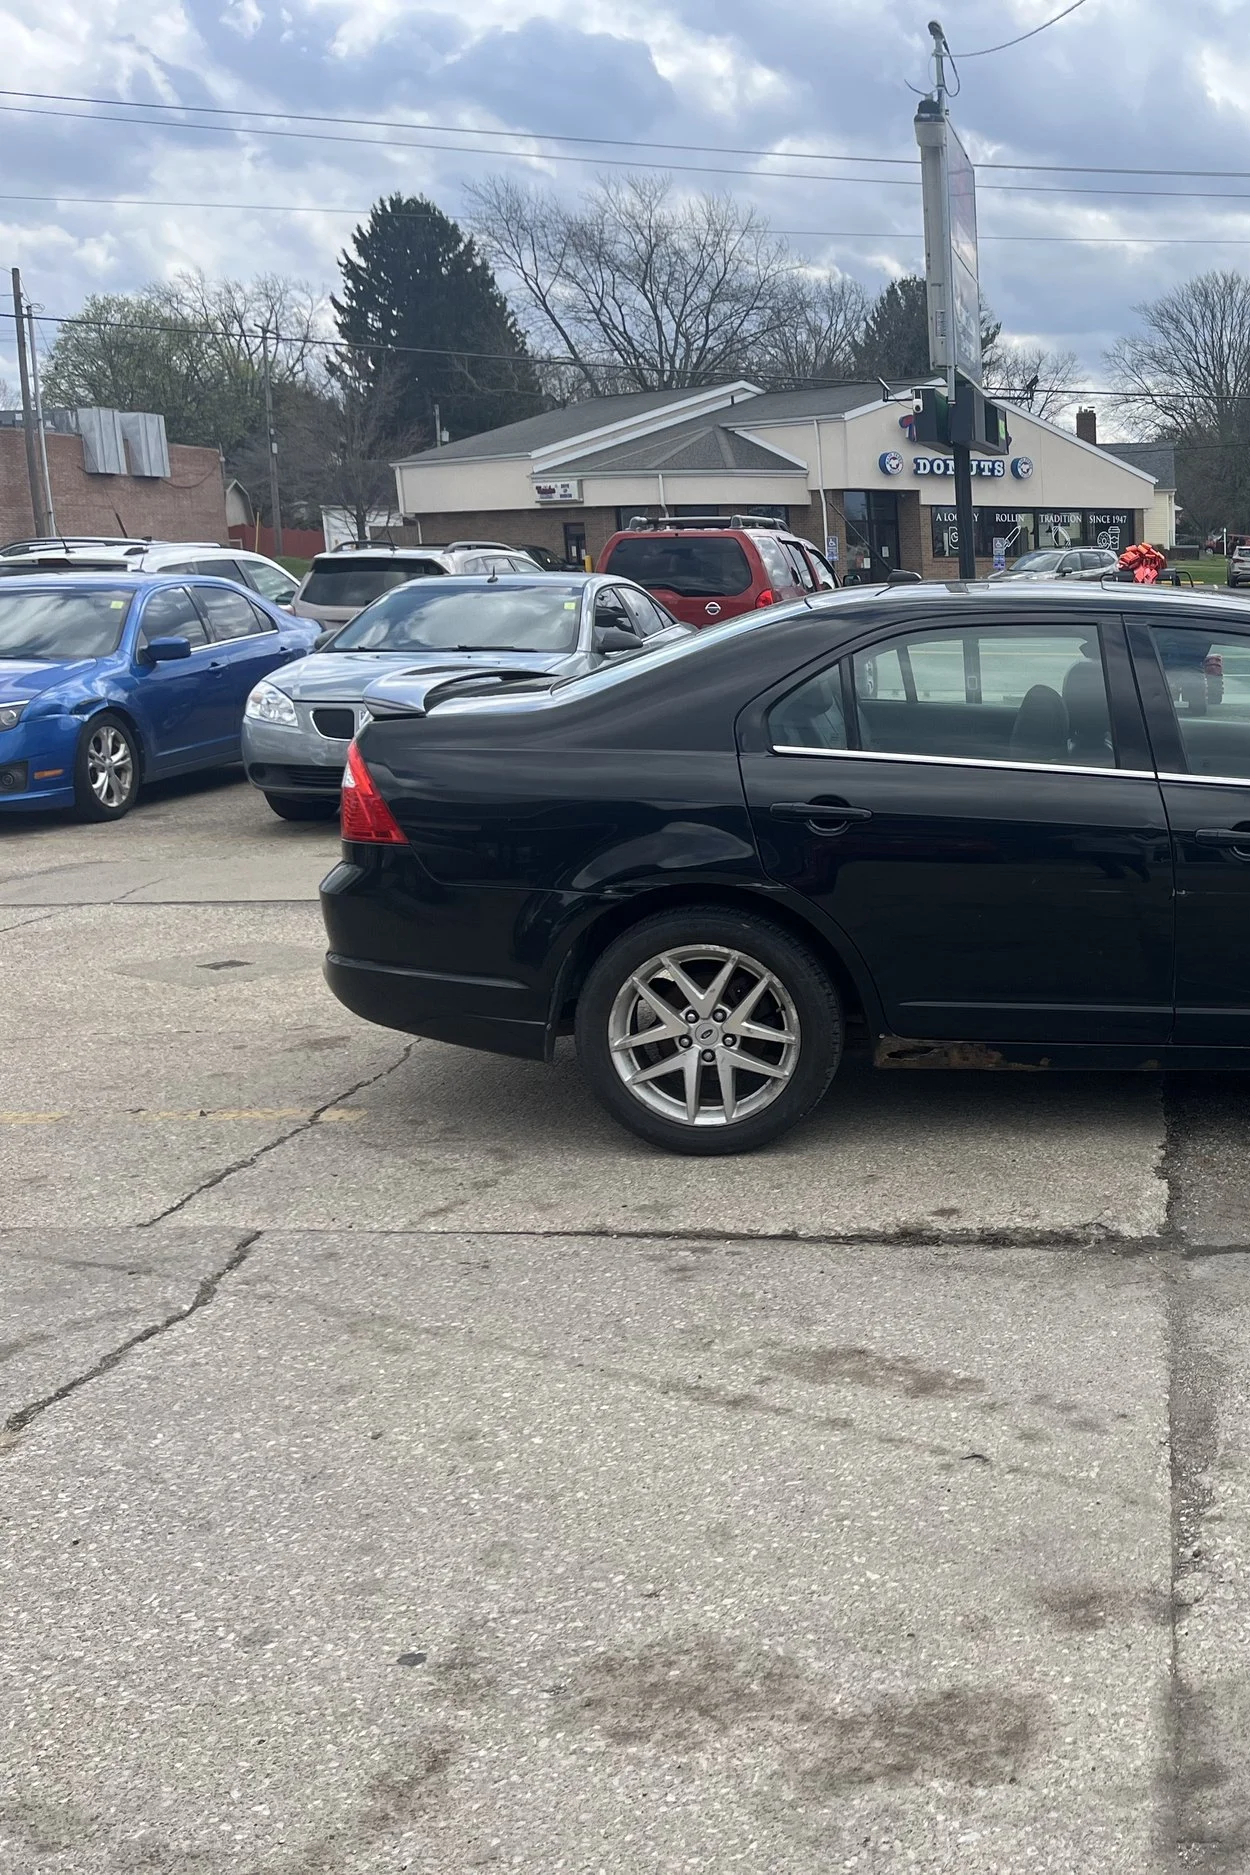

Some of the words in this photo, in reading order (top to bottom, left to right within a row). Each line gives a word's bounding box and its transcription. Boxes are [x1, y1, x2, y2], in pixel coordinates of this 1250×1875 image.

[1040, 514, 1082, 523] TRADITION
[1089, 515, 1111, 524] SINCE
[1112, 515, 1127, 524] 1947
